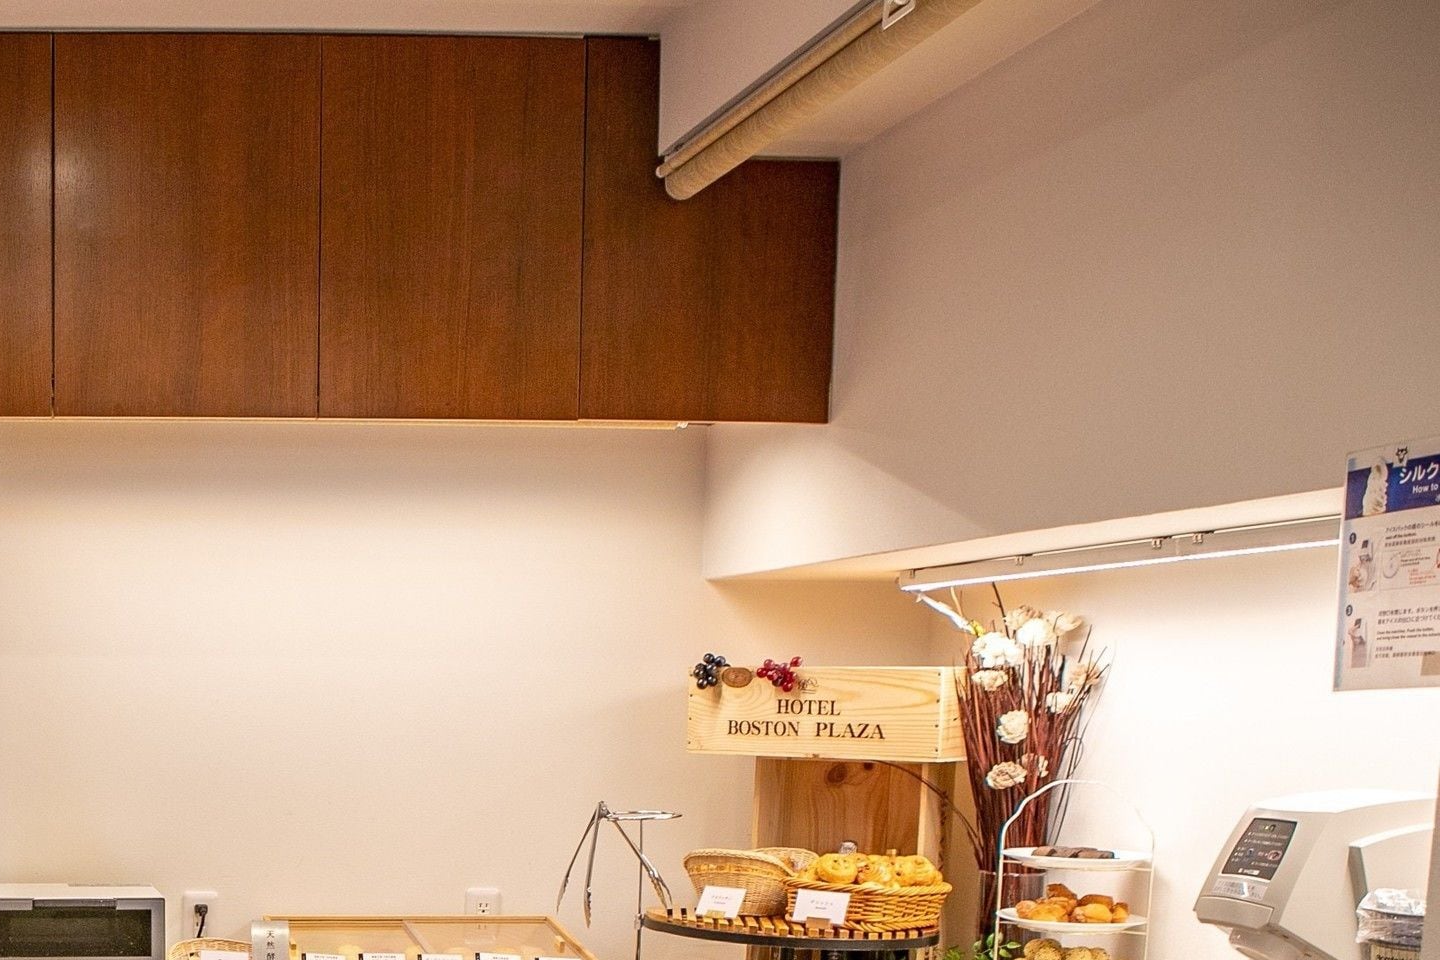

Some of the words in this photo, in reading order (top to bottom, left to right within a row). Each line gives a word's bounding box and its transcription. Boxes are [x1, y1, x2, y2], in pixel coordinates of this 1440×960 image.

[1413, 486, 1429, 494] How
[777, 699, 840, 716] HOTEL
[728, 720, 799, 736] BOSTON
[816, 722, 886, 740] PLAZA
